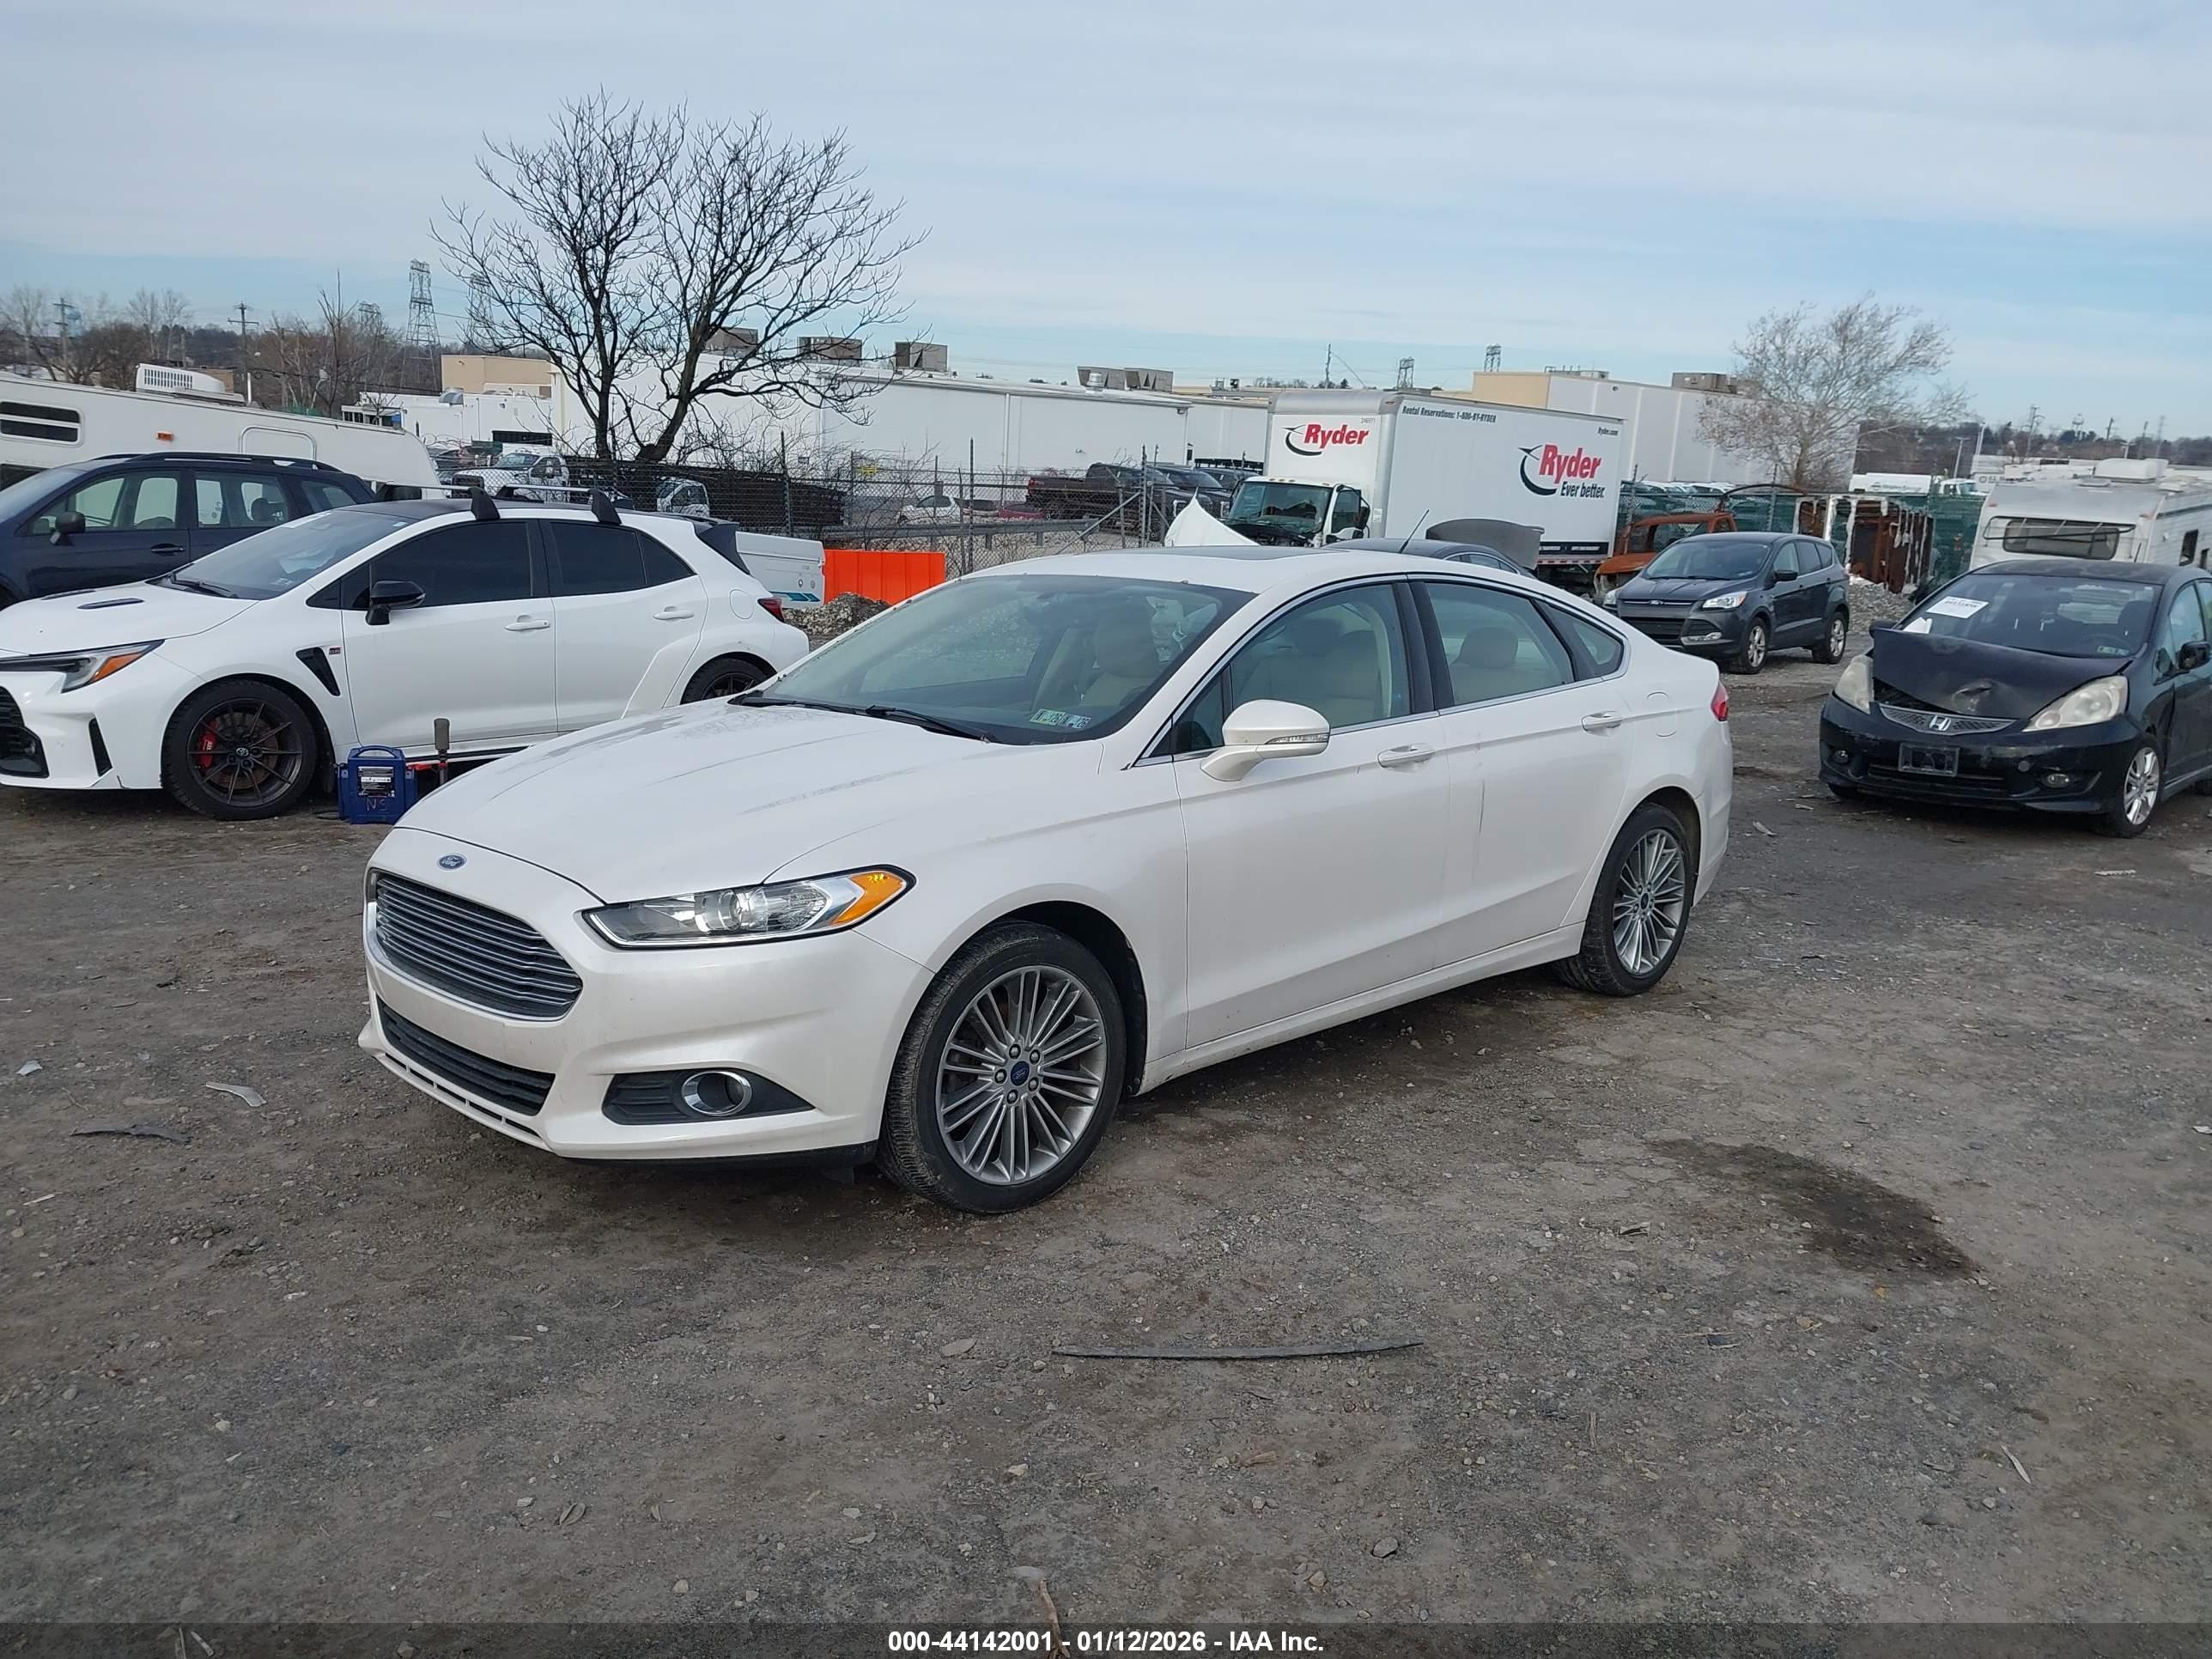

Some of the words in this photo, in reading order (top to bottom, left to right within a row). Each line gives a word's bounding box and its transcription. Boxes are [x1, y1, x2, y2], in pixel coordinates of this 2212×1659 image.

[1402, 405, 1419, 416] Rental
[1304, 423, 1370, 449] Ryder
[1539, 444, 1601, 484] Ryder
[1560, 481, 1579, 497] Ever
[1580, 483, 1606, 498] better.
